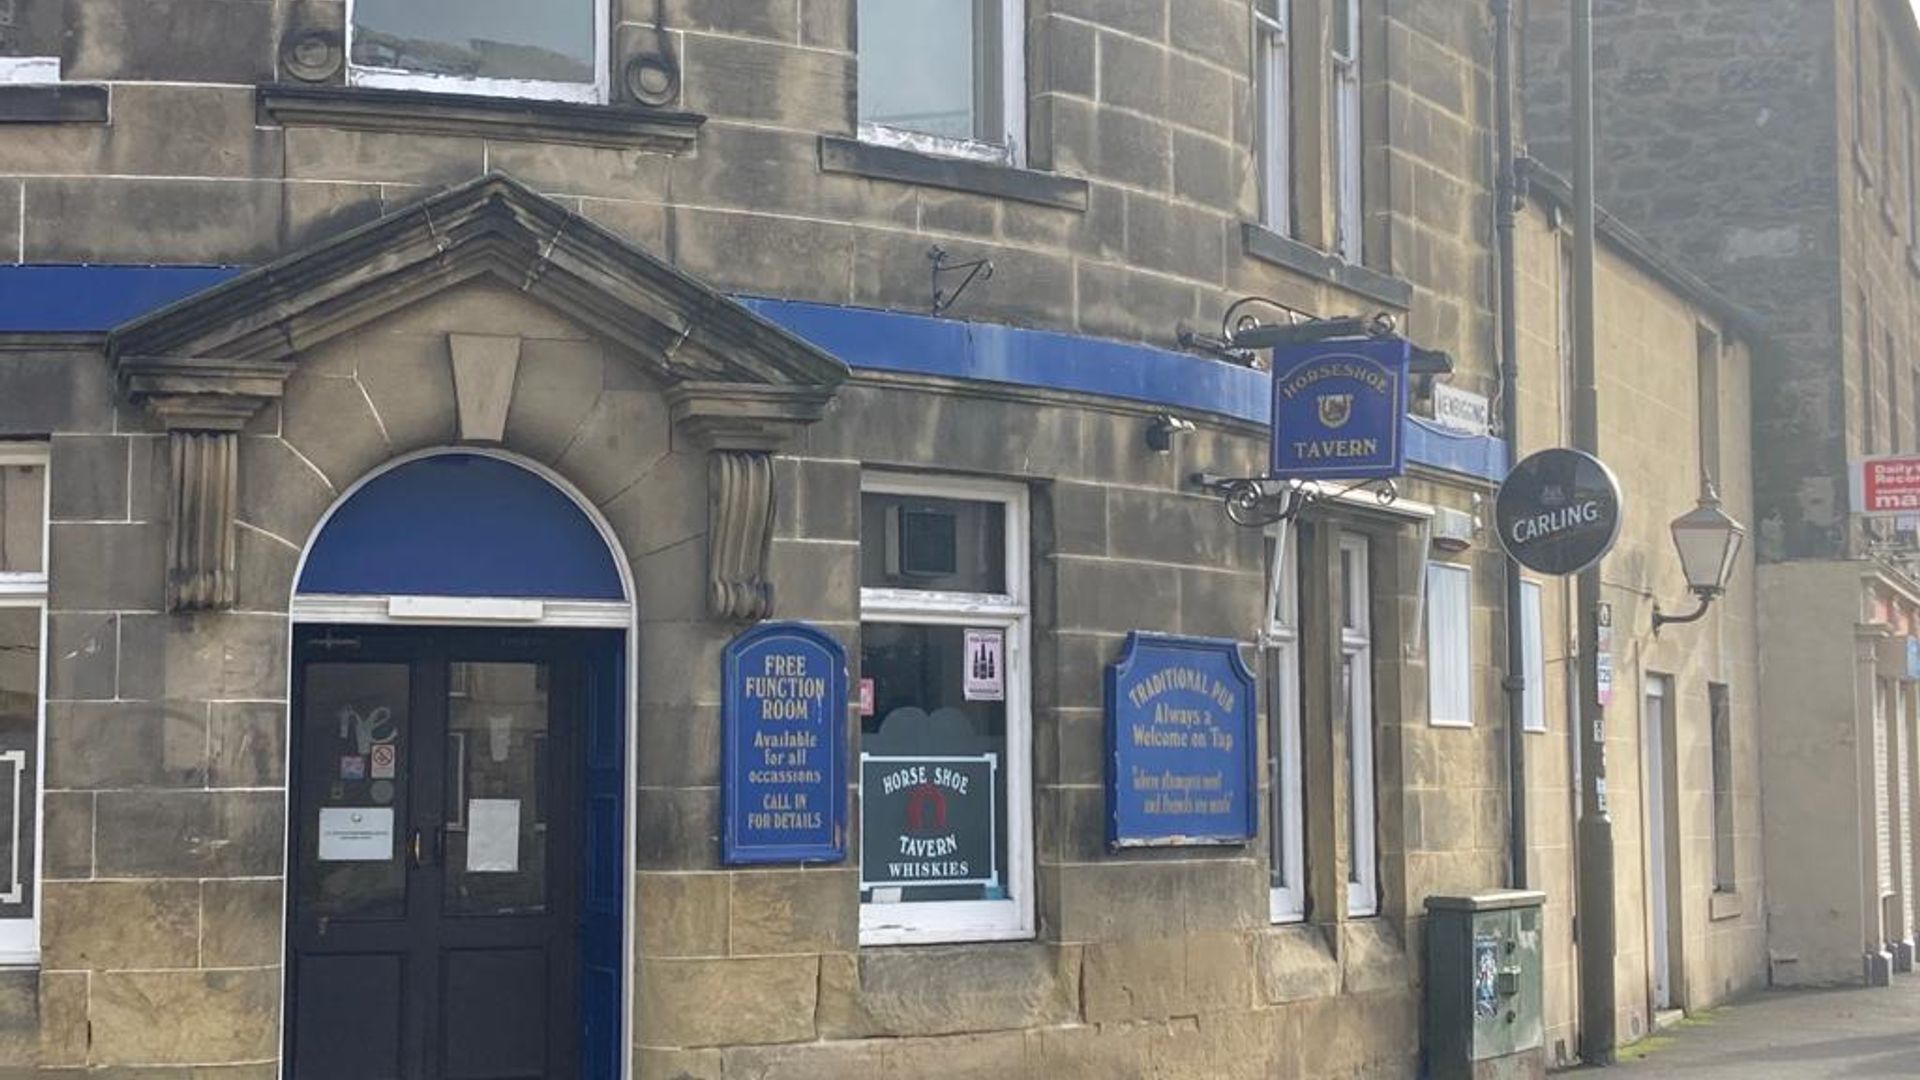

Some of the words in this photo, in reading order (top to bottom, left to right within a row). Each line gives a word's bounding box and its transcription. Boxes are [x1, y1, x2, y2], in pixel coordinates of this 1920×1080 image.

[1282, 363, 1387, 400] HORSESHOE
[1293, 438, 1378, 459] TAVERN
[1874, 463, 1912, 475] Daily
[1512, 500, 1598, 544] CARLING
[765, 655, 807, 677] FREE
[746, 676, 825, 699] FUNCTION
[1128, 666, 1208, 709] TRADITIONAL
[1211, 680, 1235, 713] PUB
[762, 699, 808, 720] ROOM
[1155, 702, 1201, 731] Always
[1204, 711, 1212, 726] a
[753, 731, 817, 748] Available
[1132, 723, 1188, 748] Welcome
[1191, 733, 1207, 748] on
[1210, 726, 1233, 753] Tap
[764, 748, 785, 766] for
[788, 748, 807, 766] all
[748, 770, 822, 784] occassions
[882, 765, 928, 796] HORSE
[933, 766, 969, 796] SHOE
[763, 793, 793, 811] CALL
[794, 793, 807, 811] IN
[747, 812, 771, 831] FOR
[773, 812, 823, 830] DETAILS
[899, 833, 958, 858] TAVERN
[888, 861, 970, 878] WHISKIES
